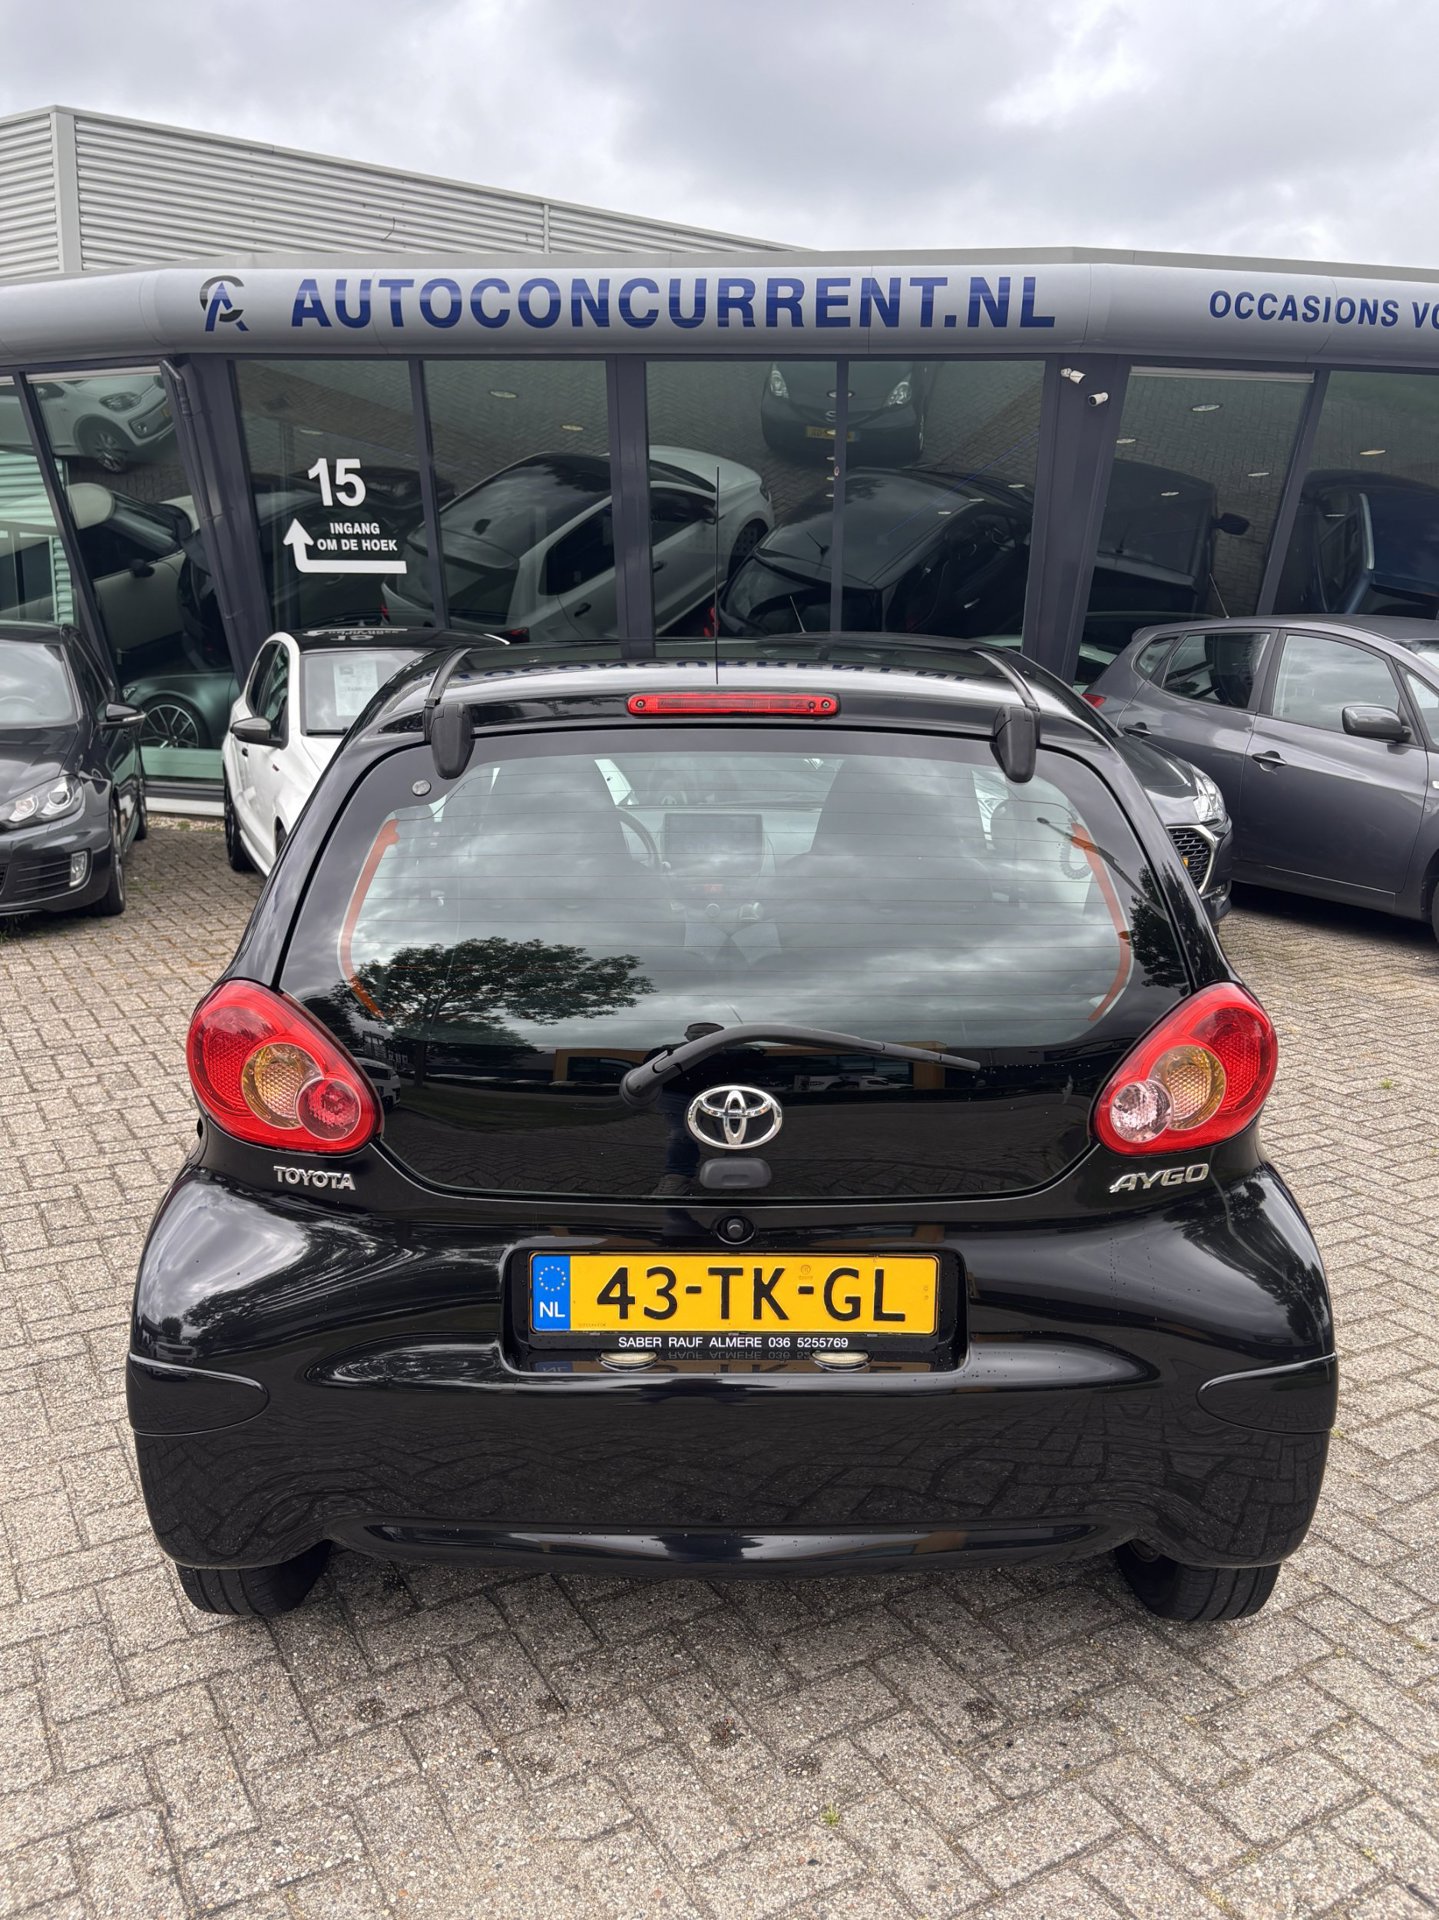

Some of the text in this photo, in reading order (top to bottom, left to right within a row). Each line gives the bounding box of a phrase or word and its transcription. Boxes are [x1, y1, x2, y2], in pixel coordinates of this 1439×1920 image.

[291, 276, 1056, 329] AUTOCONCURRENT.NL
[1209, 290, 1399, 327] OCCASIONS
[308, 458, 366, 507] 15
[329, 523, 380, 535] INGANG
[317, 538, 398, 551] OM DE HOEK
[273, 1165, 356, 1191] TOYOTA
[1109, 1163, 1210, 1193] AYGO
[596, 1266, 906, 1322] 43-TK-GL
[539, 1301, 566, 1319] NL
[618, 1336, 849, 1349] SABER RAUF ALMERE 036 5255769
